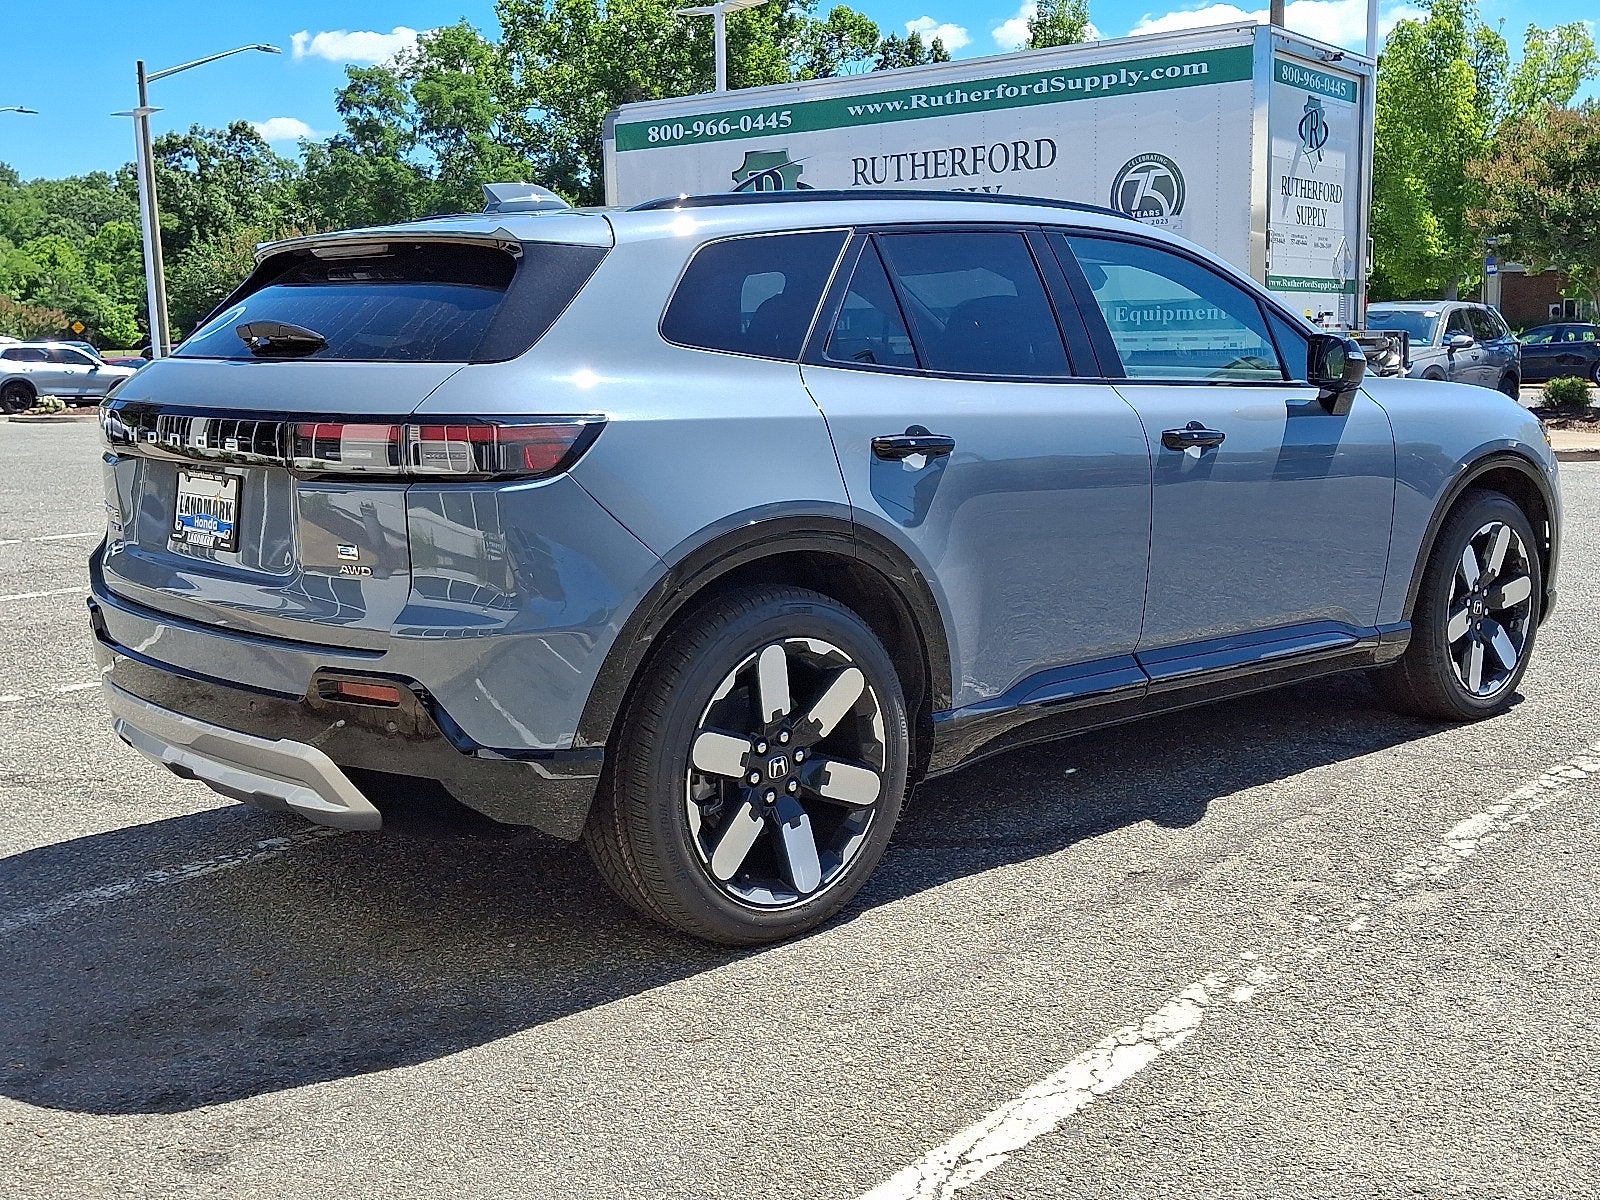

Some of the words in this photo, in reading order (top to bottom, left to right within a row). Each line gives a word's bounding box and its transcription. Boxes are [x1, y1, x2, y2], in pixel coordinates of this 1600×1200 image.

[1281, 65, 1347, 96] 800-966-0445
[648, 110, 792, 143] 800-966-0445
[847, 60, 1209, 116] www.RutherfordSupply.com
[852, 138, 1057, 186] RUTHERFORD
[1127, 154, 1168, 168] CELEBRATING
[1281, 176, 1343, 203] RUTHERFORD
[1131, 209, 1160, 218] YEARS
[1296, 204, 1328, 227] SUPPLY
[179, 493, 234, 523] LANDMARK
[194, 515, 219, 531] Honda
[339, 565, 373, 577] AWD
